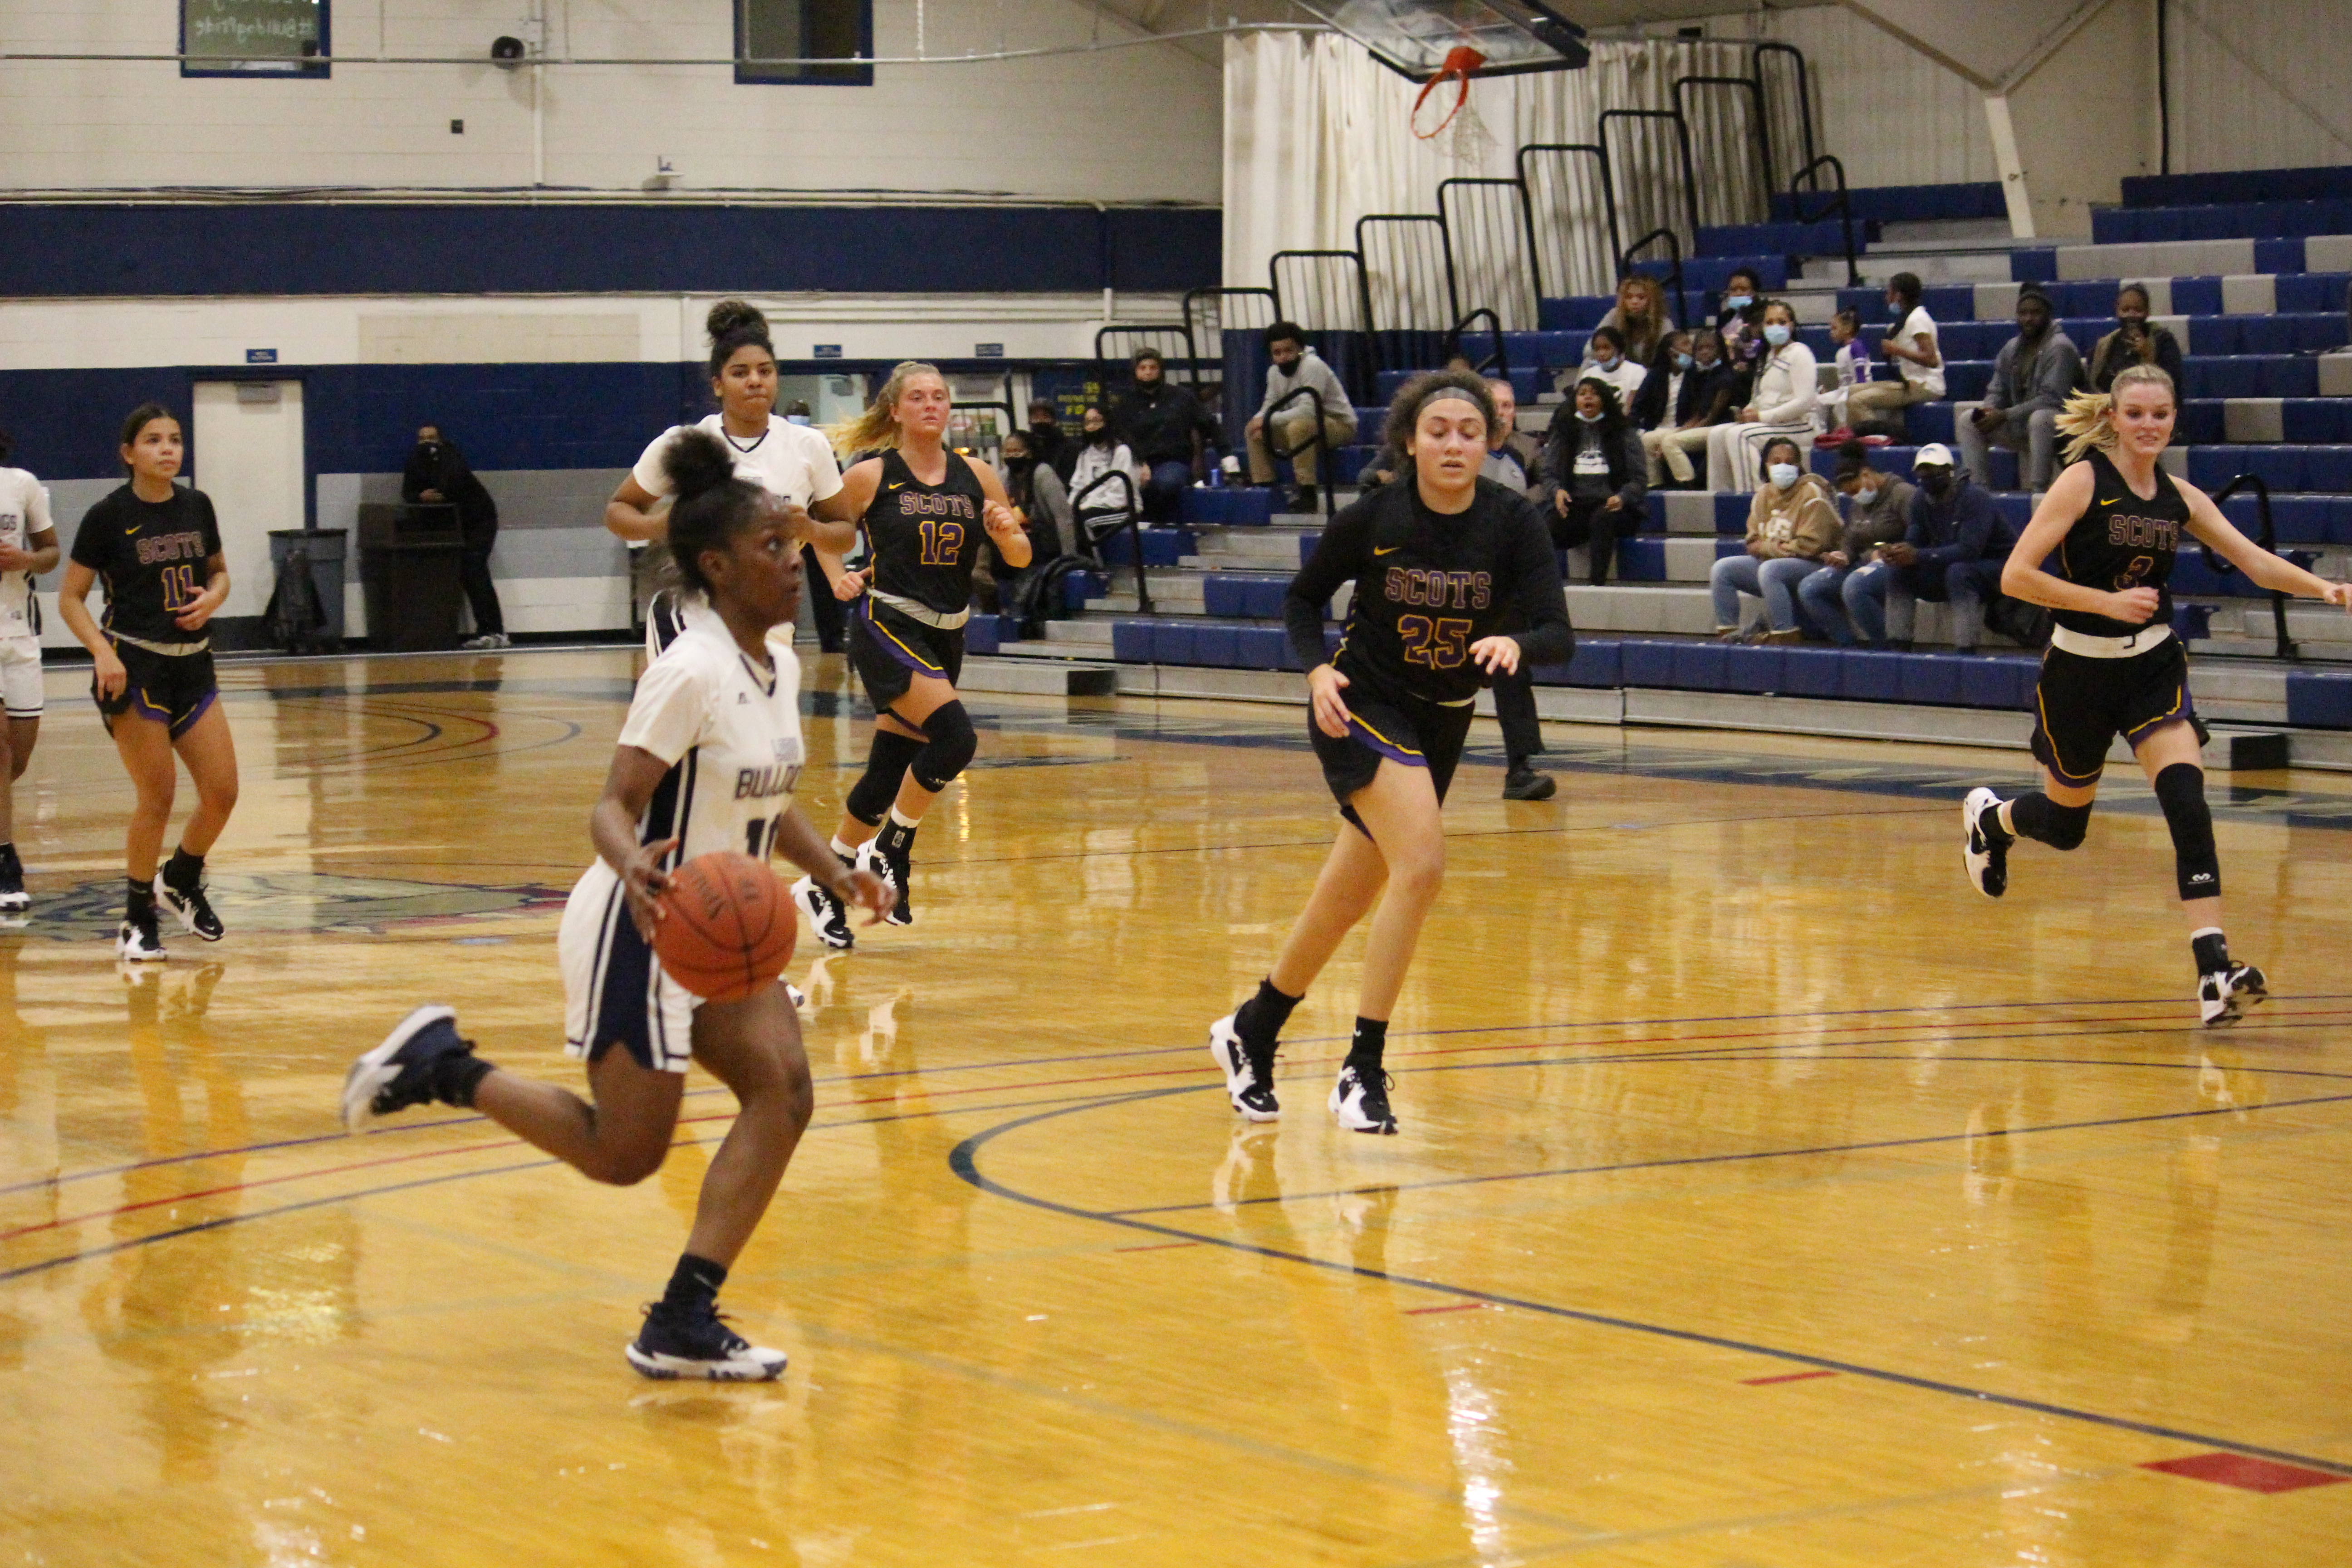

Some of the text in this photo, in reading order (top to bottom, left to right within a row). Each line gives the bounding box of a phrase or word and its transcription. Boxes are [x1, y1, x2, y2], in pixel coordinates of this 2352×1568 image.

[899, 491, 975, 519] SCOTS
[137, 531, 206, 564] SCOTS
[919, 520, 965, 565] 12
[2109, 514, 2178, 551] SCOTS
[161, 564, 194, 611] 11
[1384, 567, 1492, 609] SCOTS
[1397, 614, 1473, 670] 25
